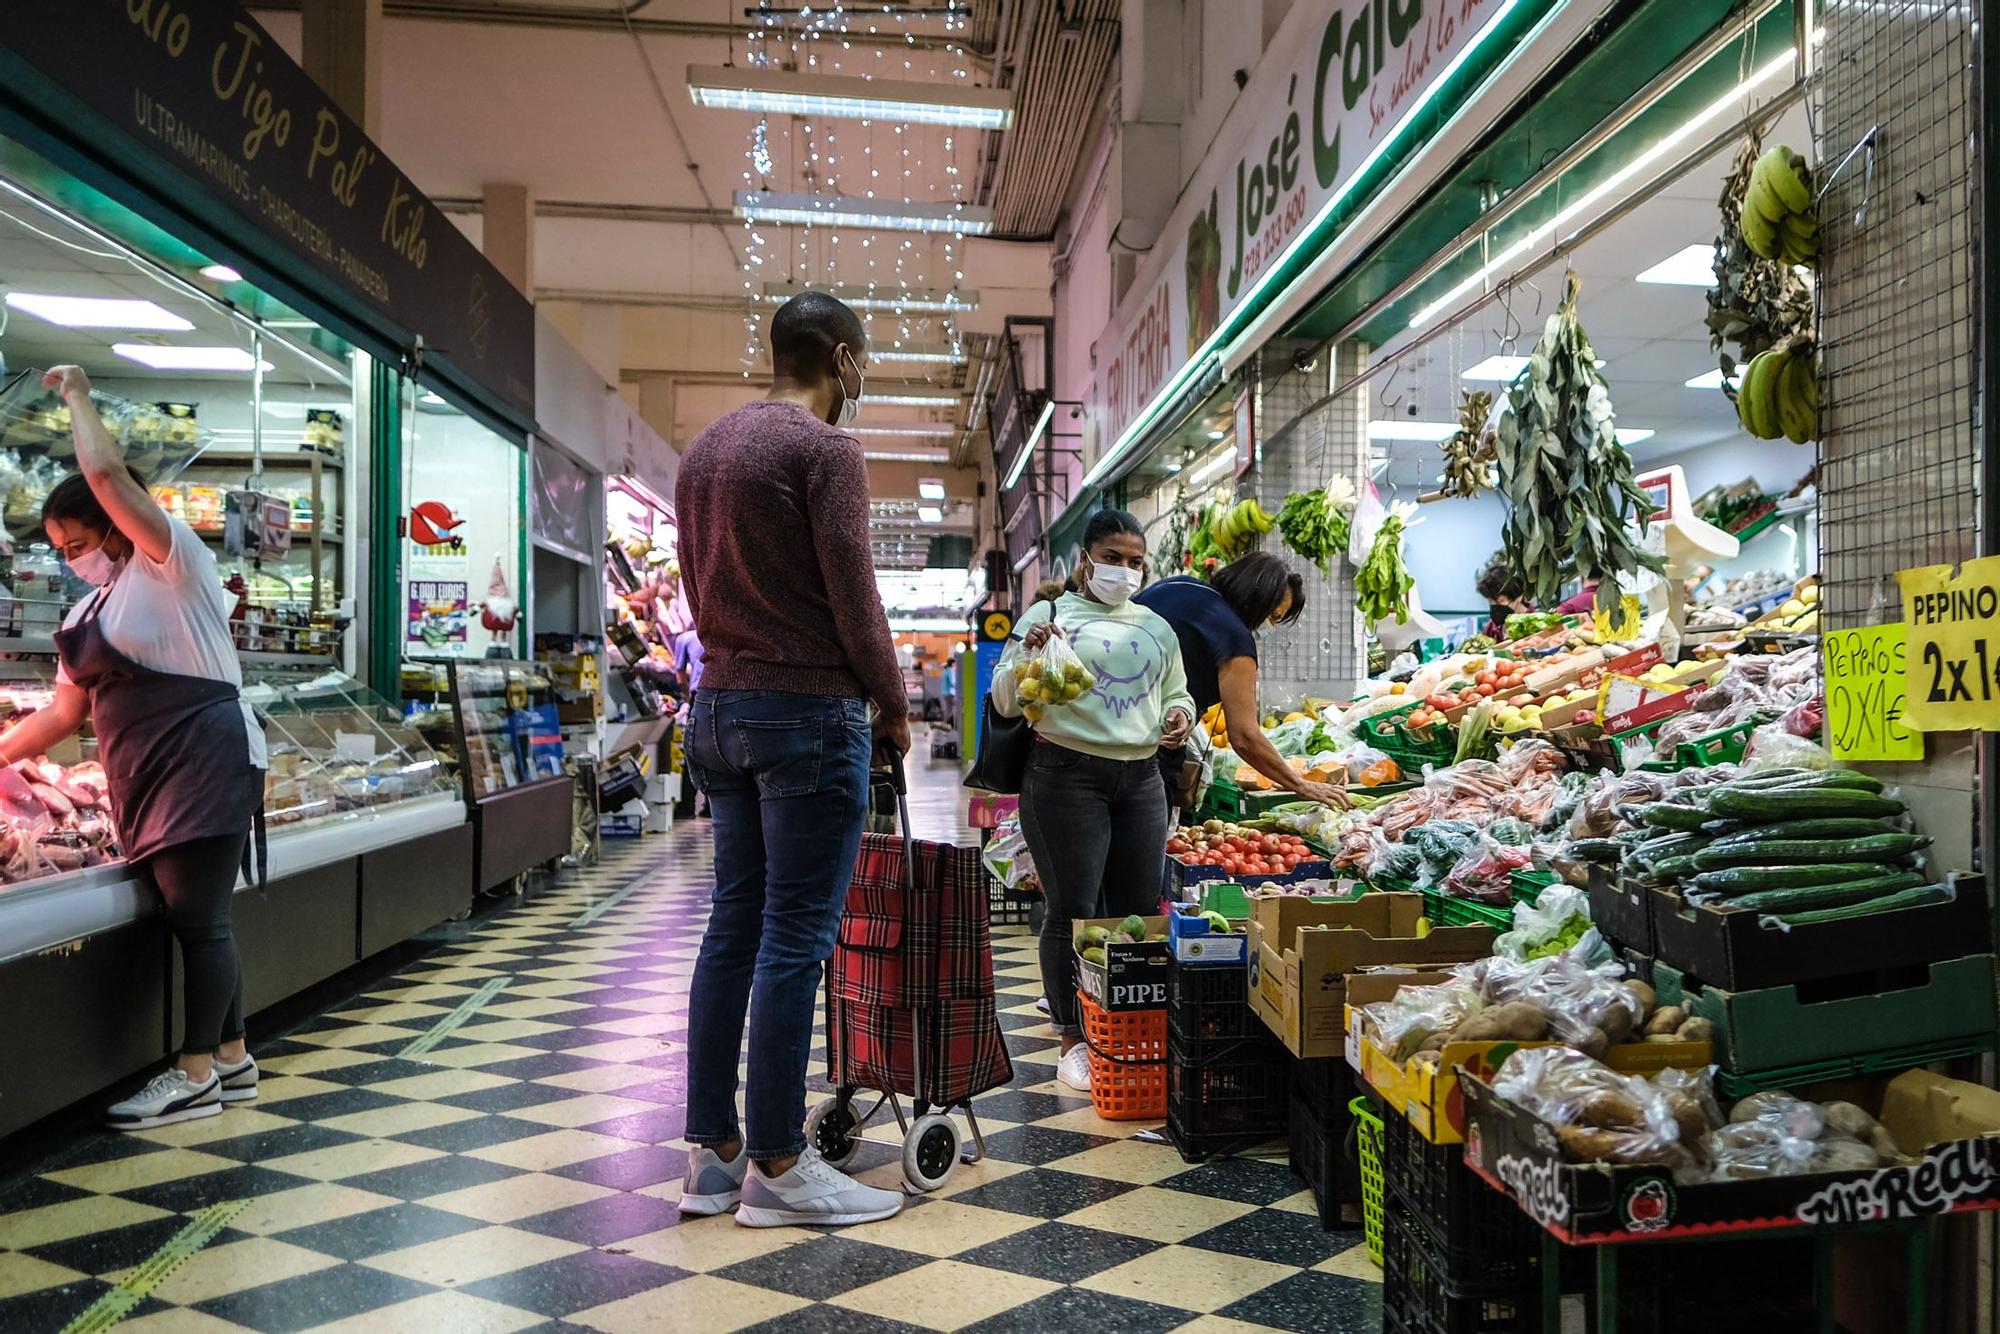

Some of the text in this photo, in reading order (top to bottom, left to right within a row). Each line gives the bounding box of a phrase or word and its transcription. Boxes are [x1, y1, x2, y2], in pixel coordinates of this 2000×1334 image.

[1369, 82, 1384, 139] Su
[1391, 17, 1431, 111] salud
[136, 88, 250, 201] ULTRAMARINOS
[1228, 72, 1300, 299] José
[381, 178, 427, 269] Kilo
[1244, 184, 1306, 283] 928 233 600
[1106, 281, 1172, 446] FRUTERÍA
[410, 583, 465, 600] 6.000 EUROS
[1913, 585, 2000, 626] PEPINO
